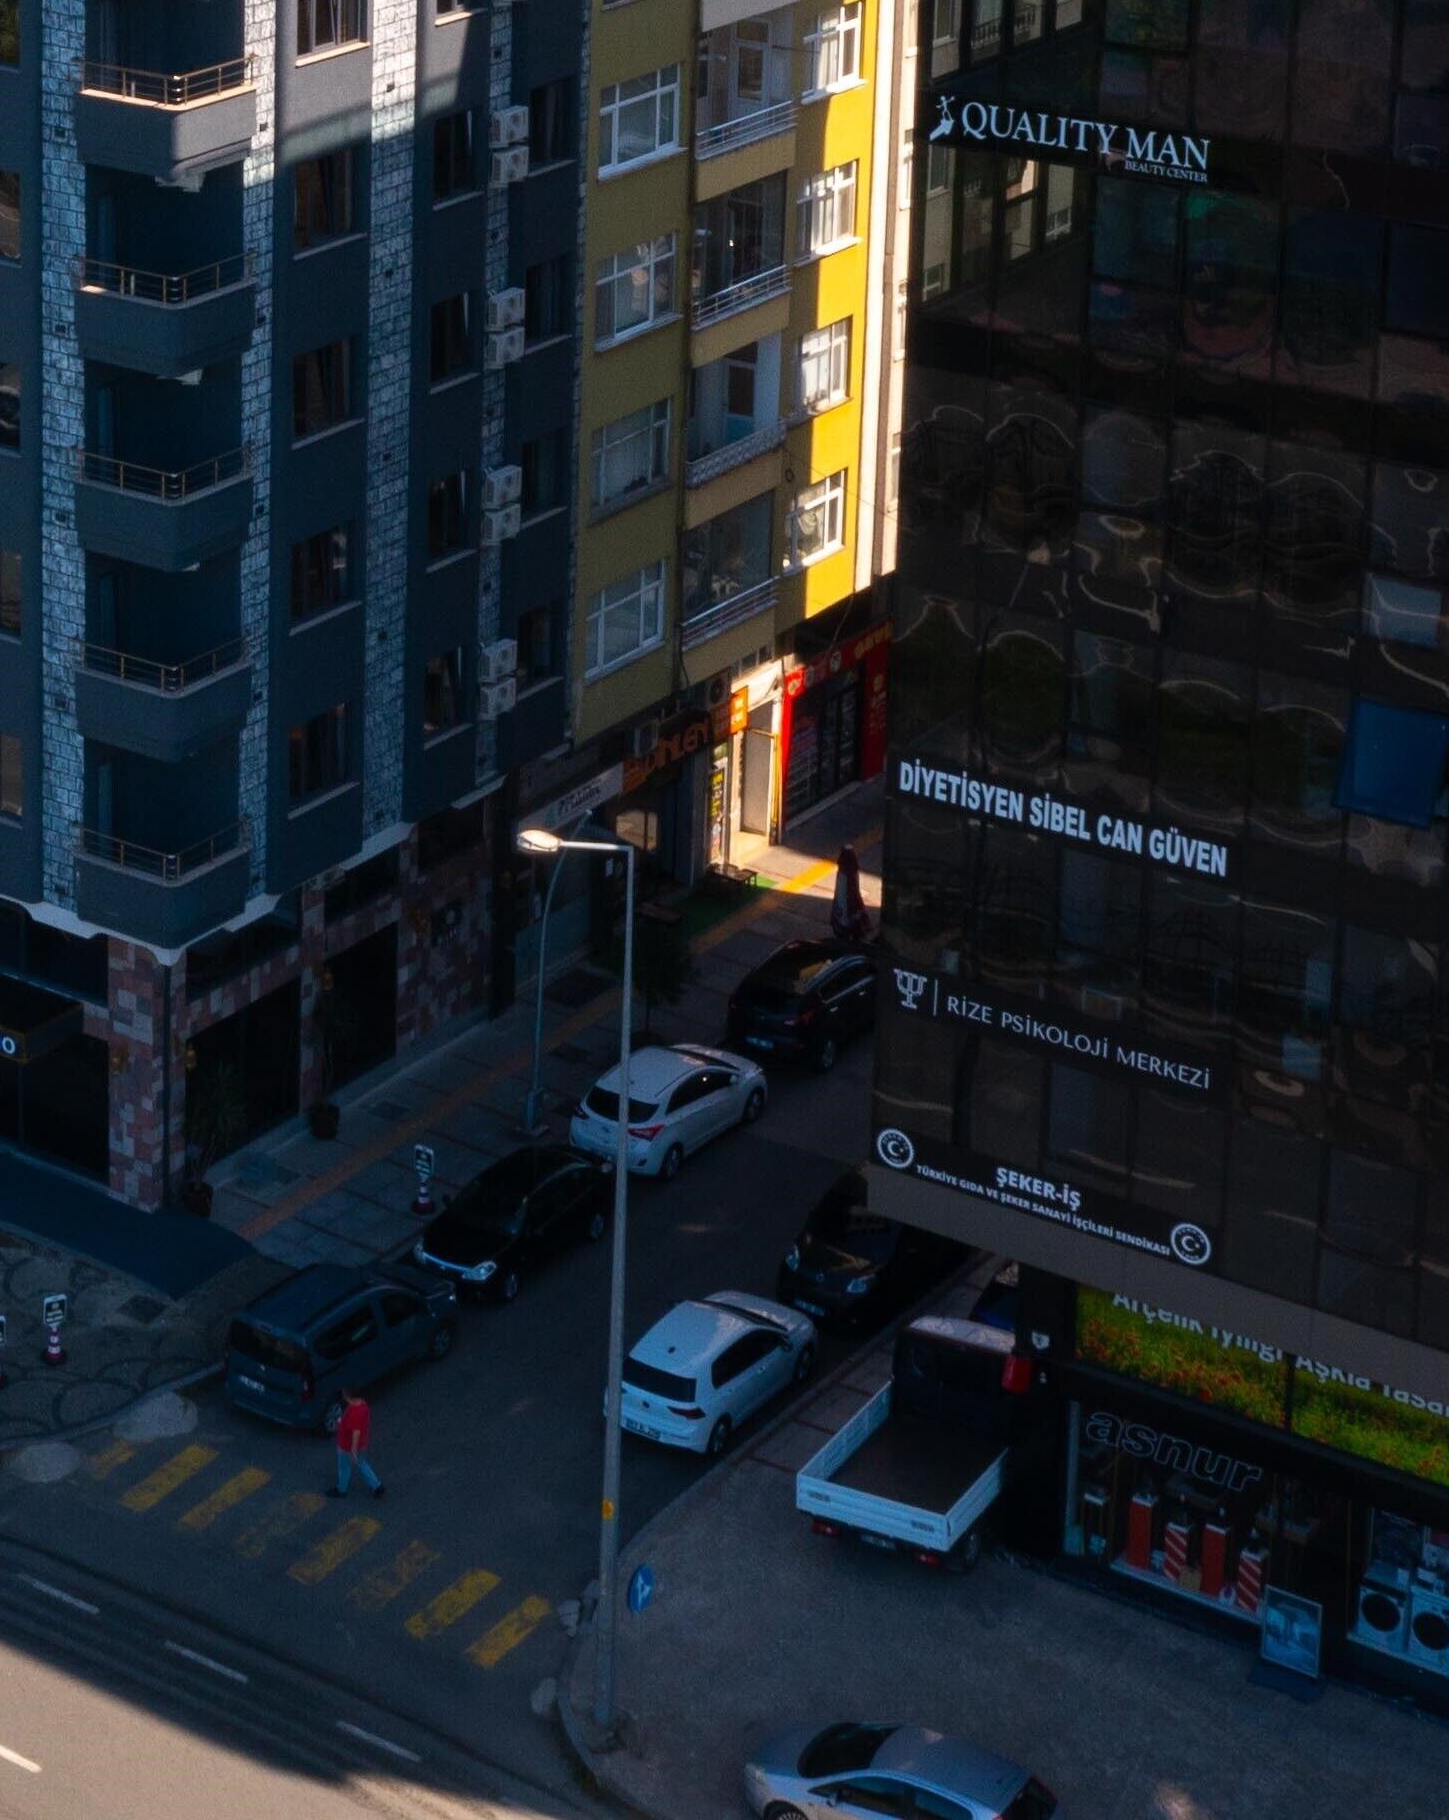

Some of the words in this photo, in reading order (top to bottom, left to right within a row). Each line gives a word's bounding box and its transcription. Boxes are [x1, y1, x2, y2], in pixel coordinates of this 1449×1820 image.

[961, 101, 1119, 155] QUALITY
[1125, 127, 1210, 171] MAN
[1124, 160, 1166, 179] BEAUTY
[1165, 167, 1208, 183] CENTER
[898, 758, 1024, 822] DİYETİSYEN
[1029, 792, 1091, 841] SİBEL
[1097, 815, 1143, 855] CAN
[1150, 826, 1227, 878] GÜVEN
[947, 995, 993, 1025] RİZE
[1000, 1013, 1109, 1059] PSİKOLOJİ
[1116, 1046, 1212, 1091] MERKEZİ
[916, 1164, 957, 1187] TÜRKİYE
[958, 1179, 984, 1196] GIDA
[986, 1187, 1000, 1201] VE
[1000, 1191, 1031, 1211] ŞEKER
[1032, 1201, 1071, 1224] SANAYİ
[1072, 1213, 1114, 1239] İŞÇİLERİ
[1115, 1230, 1171, 1257] SENDİKASI
[996, 1166, 1082, 1211] ŞEKER-İŞ
[1085, 1411, 1264, 1492] asnur
